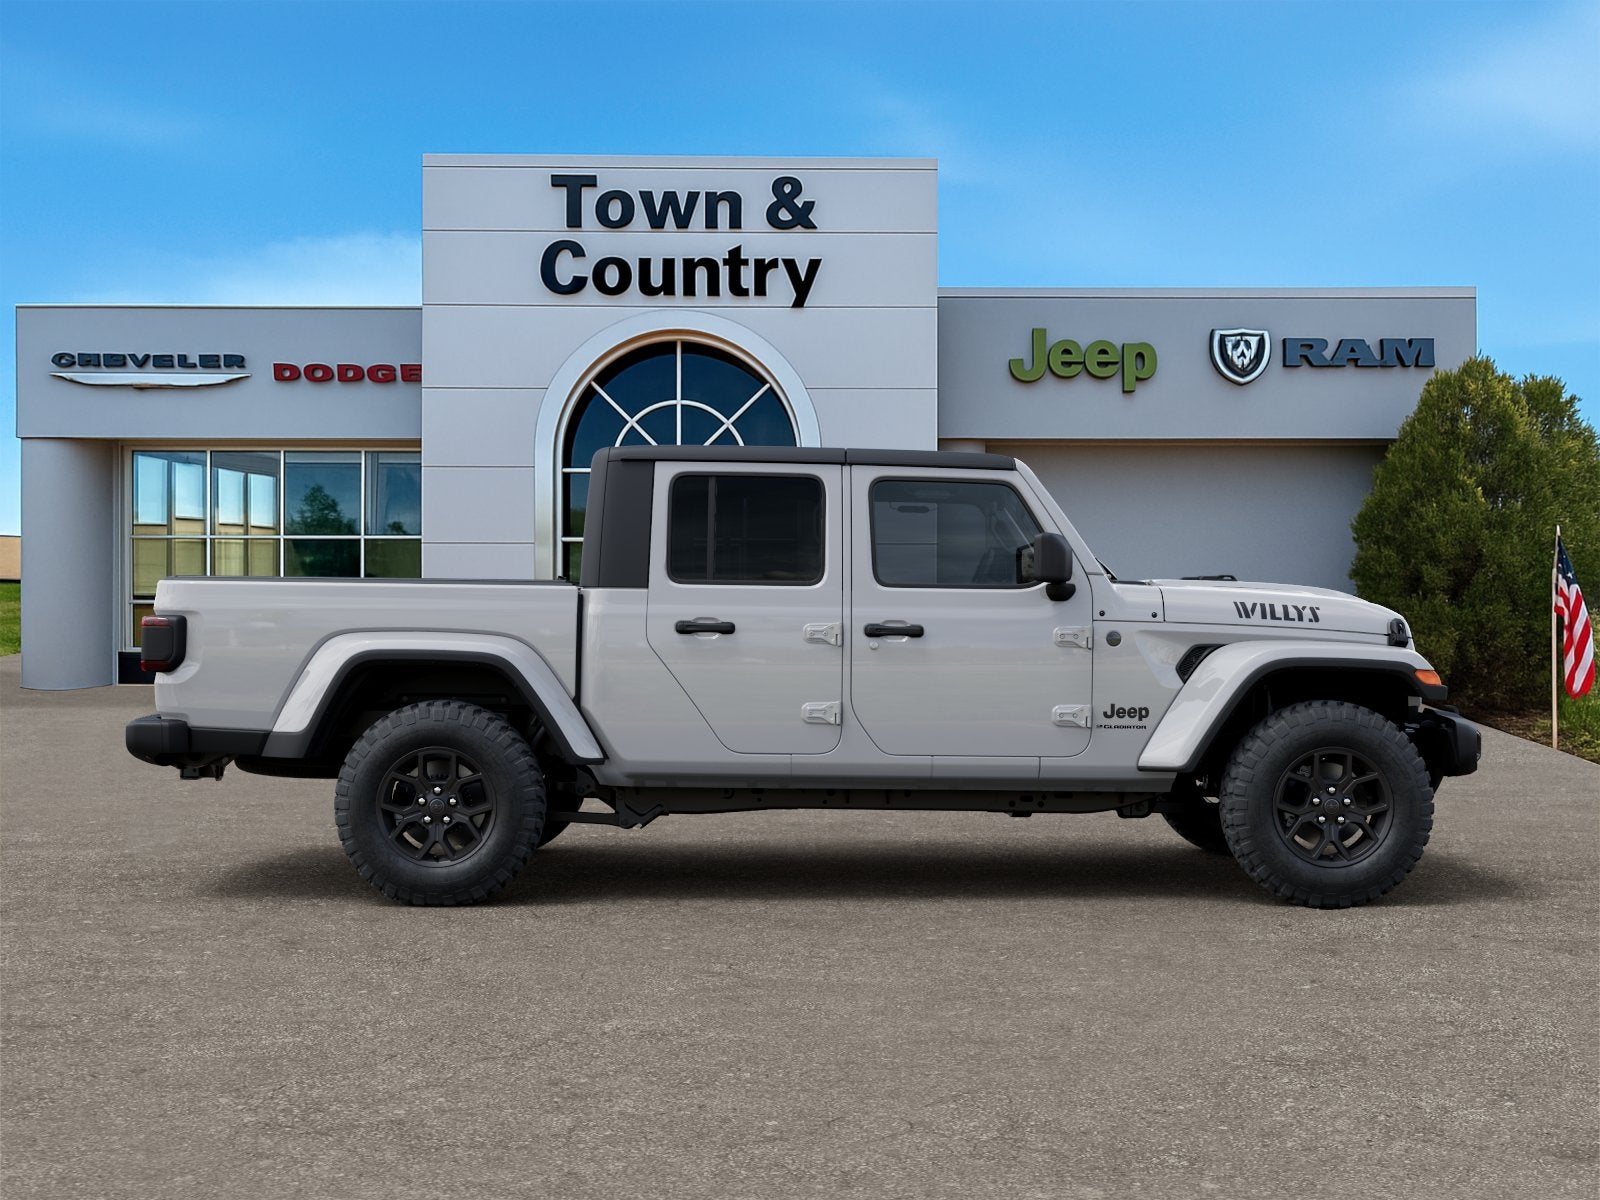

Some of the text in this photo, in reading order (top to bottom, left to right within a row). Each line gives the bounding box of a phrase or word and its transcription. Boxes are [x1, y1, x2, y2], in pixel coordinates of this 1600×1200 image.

[550, 174, 818, 230] Town &
[540, 239, 822, 308] Country
[1009, 328, 1157, 392] Jeep
[1282, 337, 1435, 368] RAM
[273, 363, 422, 383] DODGE
[1233, 601, 1320, 623] WILLYS
[1103, 703, 1149, 721] Jeep
